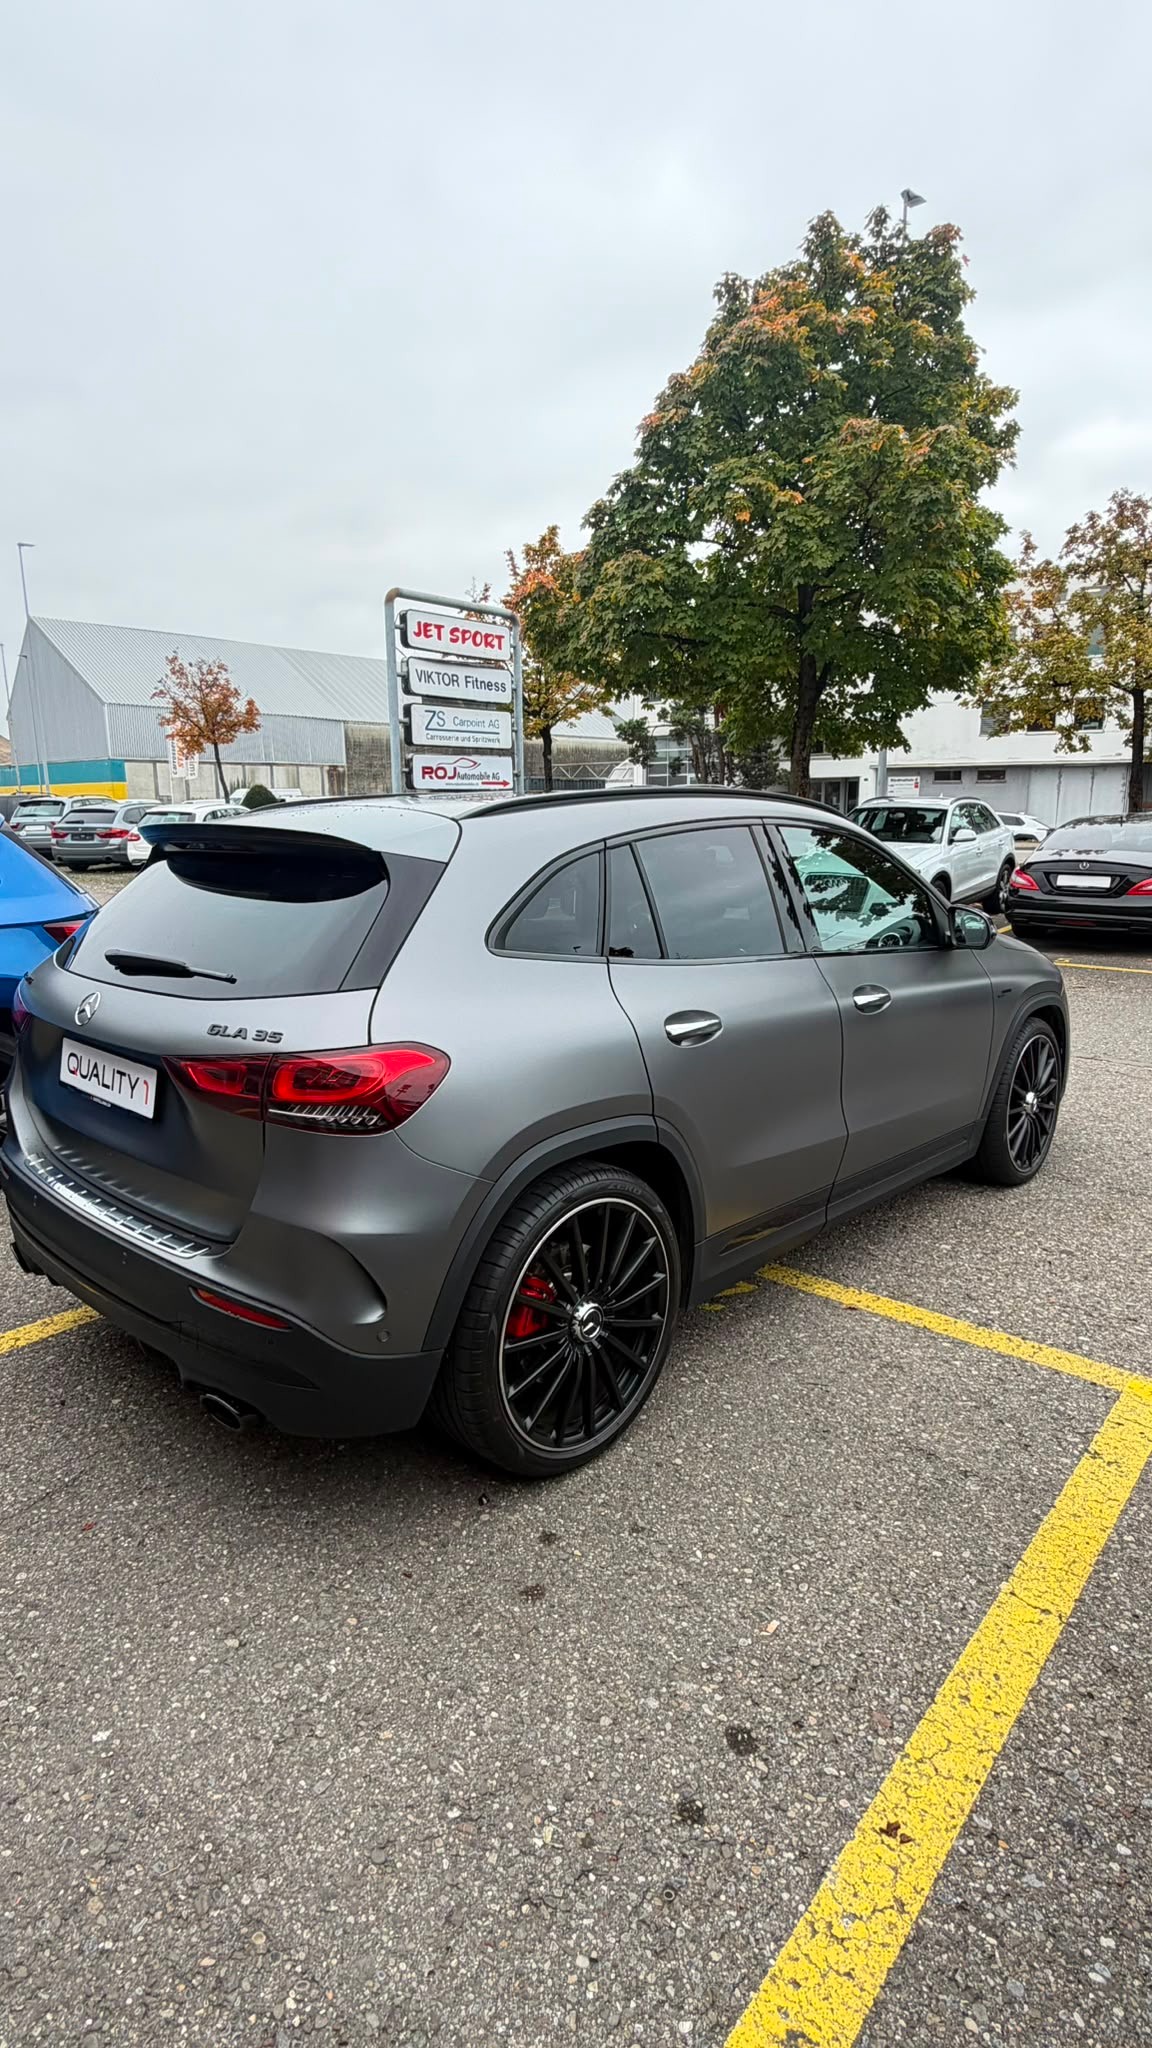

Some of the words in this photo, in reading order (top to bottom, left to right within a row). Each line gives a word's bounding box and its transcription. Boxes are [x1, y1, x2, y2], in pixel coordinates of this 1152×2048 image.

[413, 621, 445, 641] JET
[449, 627, 505, 650] SPORT
[415, 668, 460, 688] VIKTOR
[464, 675, 507, 693] Fitness
[424, 709, 446, 730] ZS
[452, 716, 486, 728] Carpoint
[488, 719, 500, 729] AG
[425, 733, 459, 741] Carrosserie
[472, 735, 501, 744] Spritzwerk
[421, 766, 457, 780] ROJ
[457, 771, 491, 781] Automobile
[492, 772, 500, 781] AG
[206, 1023, 248, 1040] GLA
[251, 1029, 284, 1044] 35
